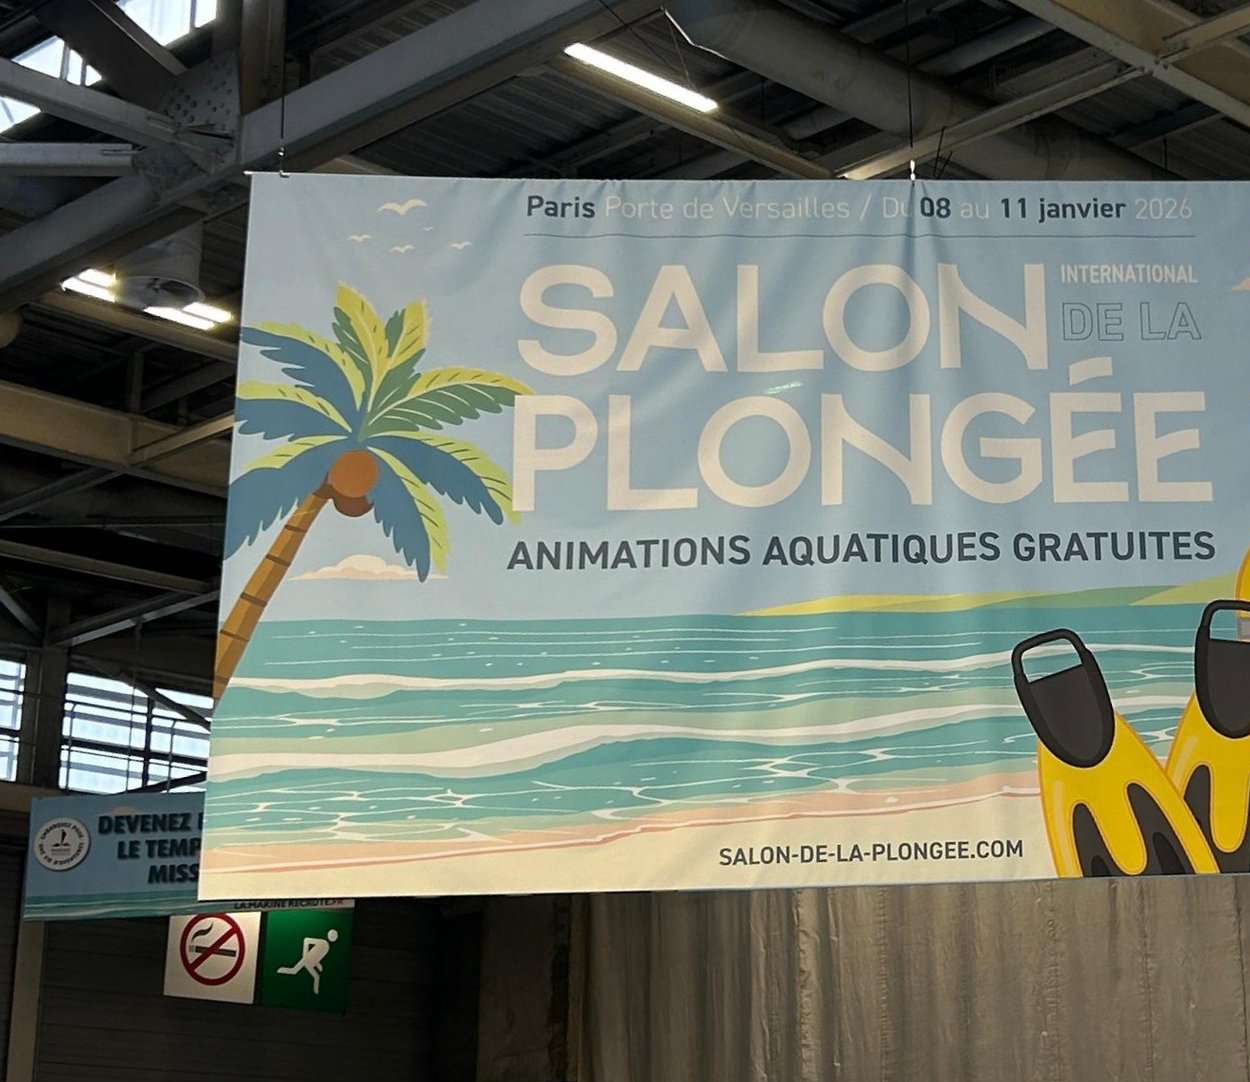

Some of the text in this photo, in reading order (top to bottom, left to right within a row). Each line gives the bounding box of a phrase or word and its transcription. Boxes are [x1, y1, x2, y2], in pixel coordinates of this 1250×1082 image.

[527, 195, 596, 219] Paris
[604, 195, 674, 220] Porte
[683, 198, 714, 220] de
[723, 196, 850, 220] Versailles
[920, 196, 951, 219] 08
[960, 202, 989, 219] au
[1001, 197, 1027, 219] 11
[1038, 197, 1127, 224] janvier
[1135, 197, 1192, 220] 2026
[1060, 263, 1199, 284] INTERNATIONAL
[516, 263, 1049, 377] SALON
[1062, 301, 1202, 342] DE LA
[511, 356, 1214, 512] PLONGÉE
[507, 531, 1216, 570] ANIMATIONS AQUATIQUES GRATUITES
[97, 812, 191, 834] DEVENEZ
[117, 840, 141, 859] LE
[719, 839, 1024, 866] SALON-DE-LA-PLONGEE.COM
